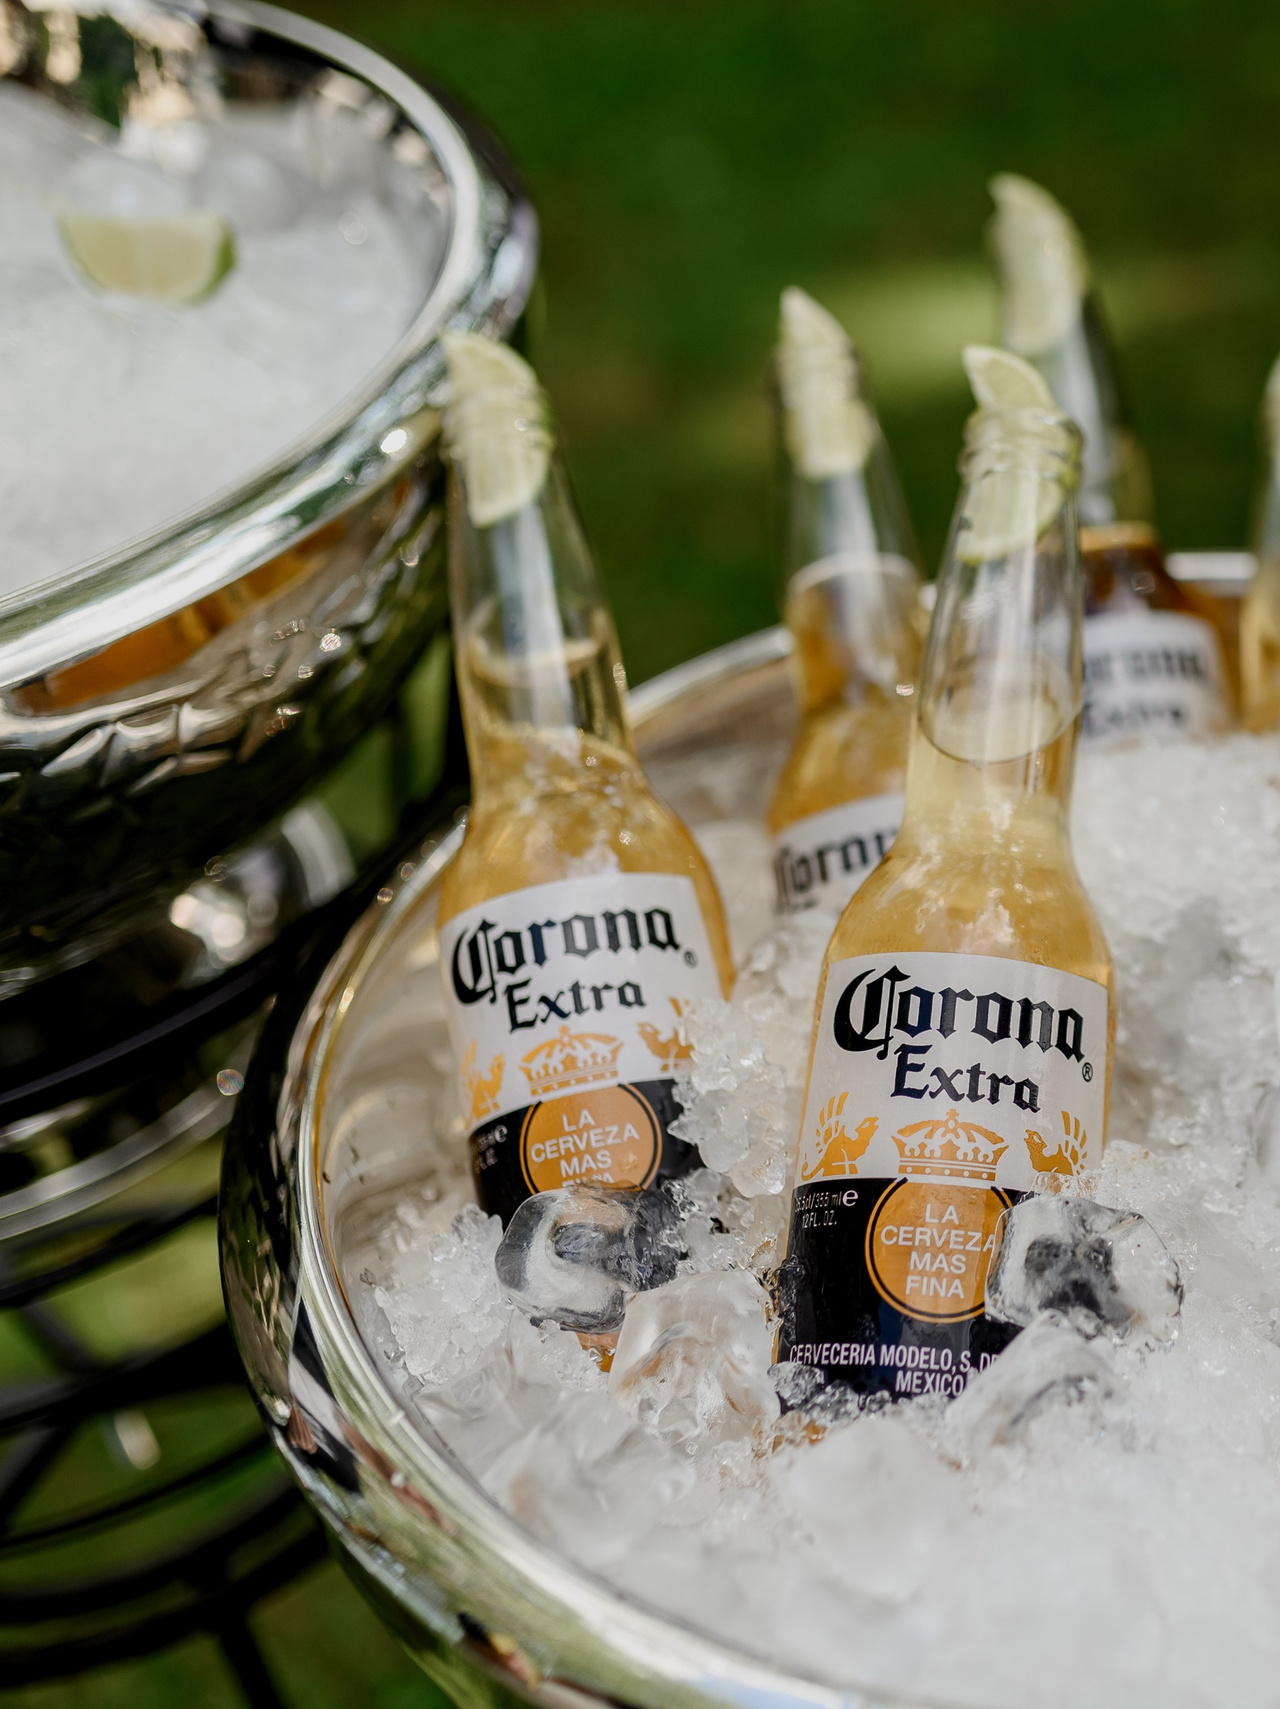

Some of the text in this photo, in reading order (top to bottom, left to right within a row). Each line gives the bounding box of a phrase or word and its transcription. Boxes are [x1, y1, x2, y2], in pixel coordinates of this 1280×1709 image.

[452, 907, 681, 1006] Corona
[504, 977, 647, 1034] Extra
[833, 964, 1086, 1064] Corona
[890, 1042, 1041, 1114] Extra
[562, 1108, 595, 1133] LA
[530, 1122, 641, 1164] CERVEZA
[559, 1151, 613, 1179] MAS
[924, 1203, 960, 1225] LA
[880, 1225, 996, 1253] CERVEZA
[909, 1250, 967, 1274] MAS
[905, 1275, 965, 1299] FINA
[789, 1342, 876, 1366] CERVECERIA
[880, 1345, 957, 1375] MODELO,
[895, 1369, 964, 1398] MEXICO
